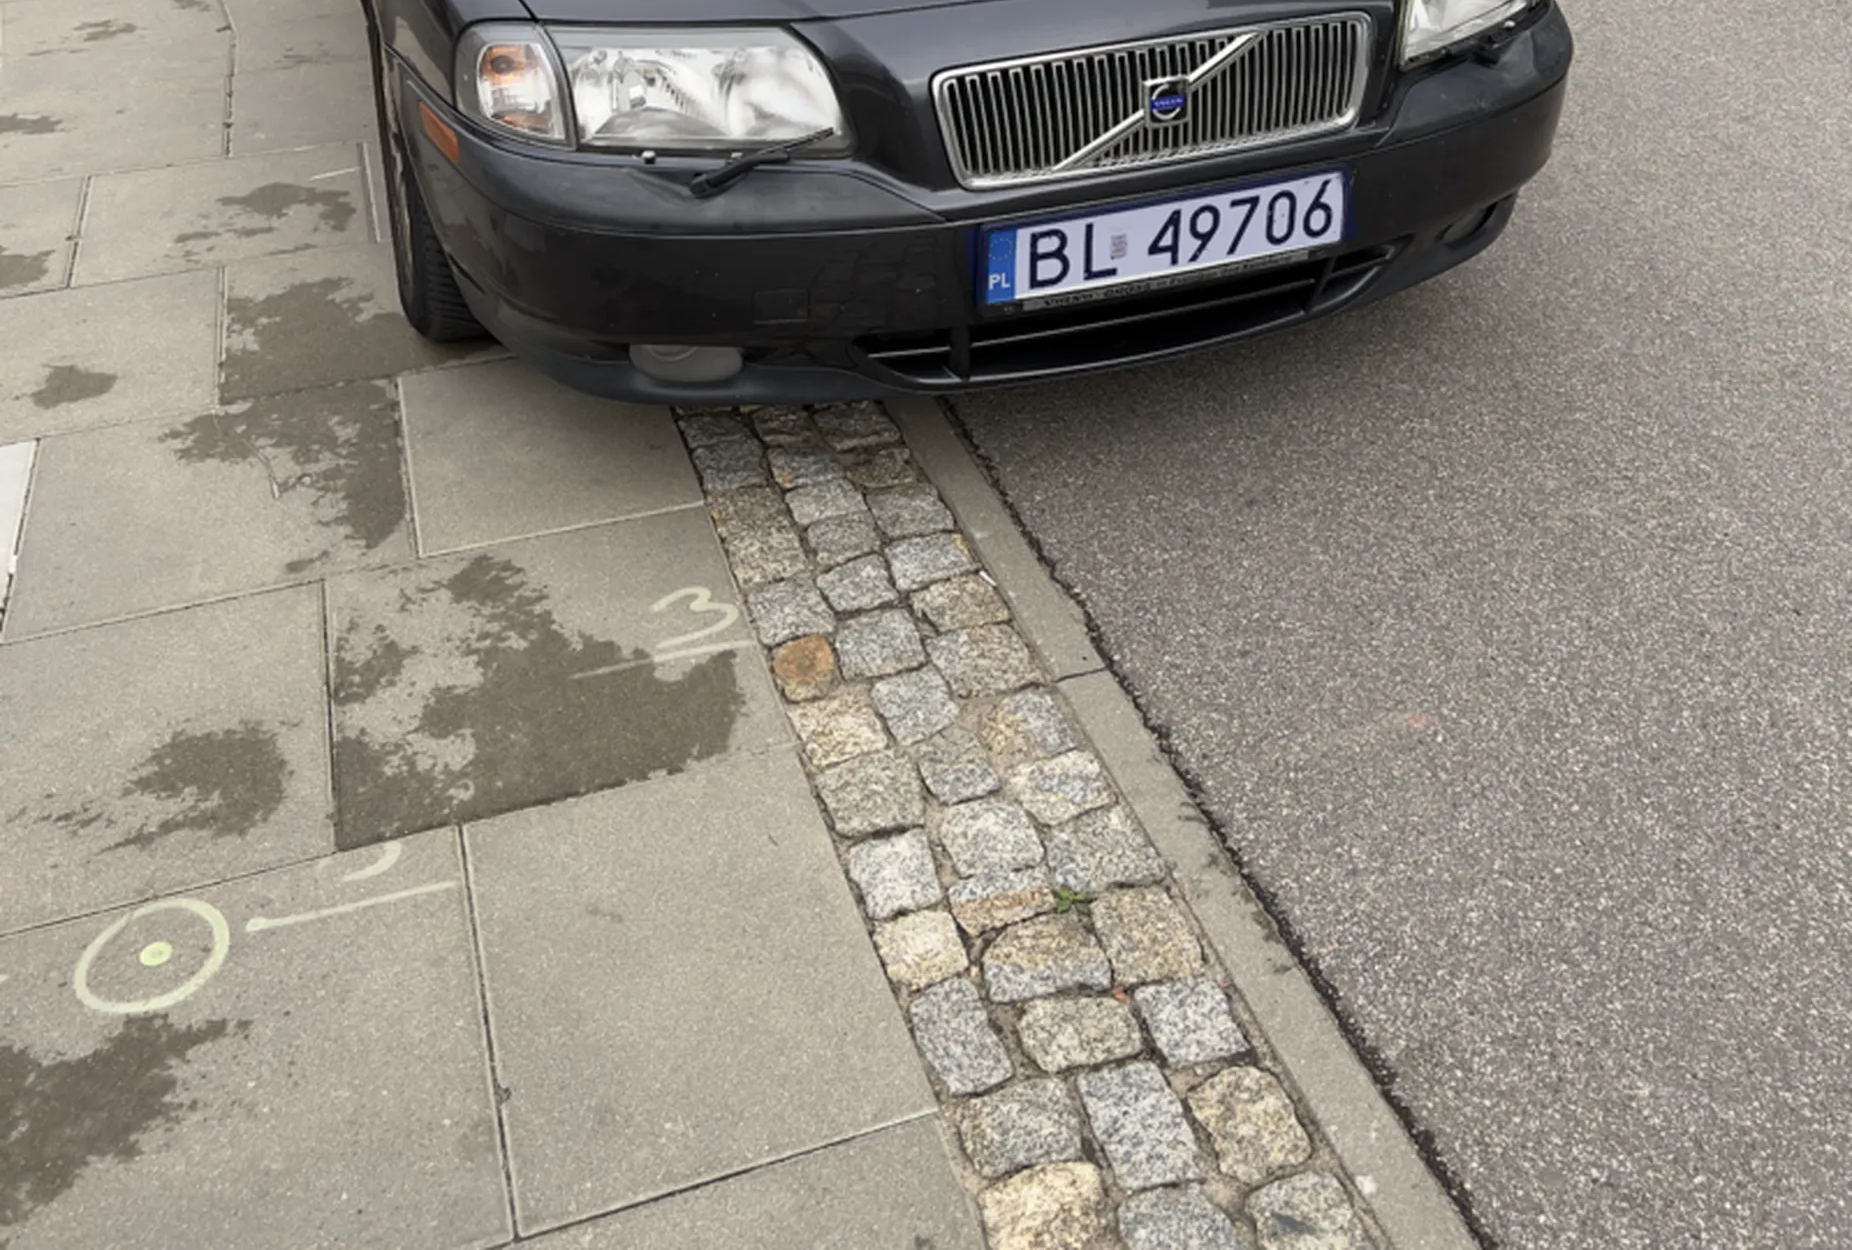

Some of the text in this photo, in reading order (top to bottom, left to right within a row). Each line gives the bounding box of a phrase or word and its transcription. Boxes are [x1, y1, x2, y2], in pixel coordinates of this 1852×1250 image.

[1028, 223, 1118, 290] BL
[1147, 179, 1333, 267] 49706
[988, 272, 1011, 291] PL
